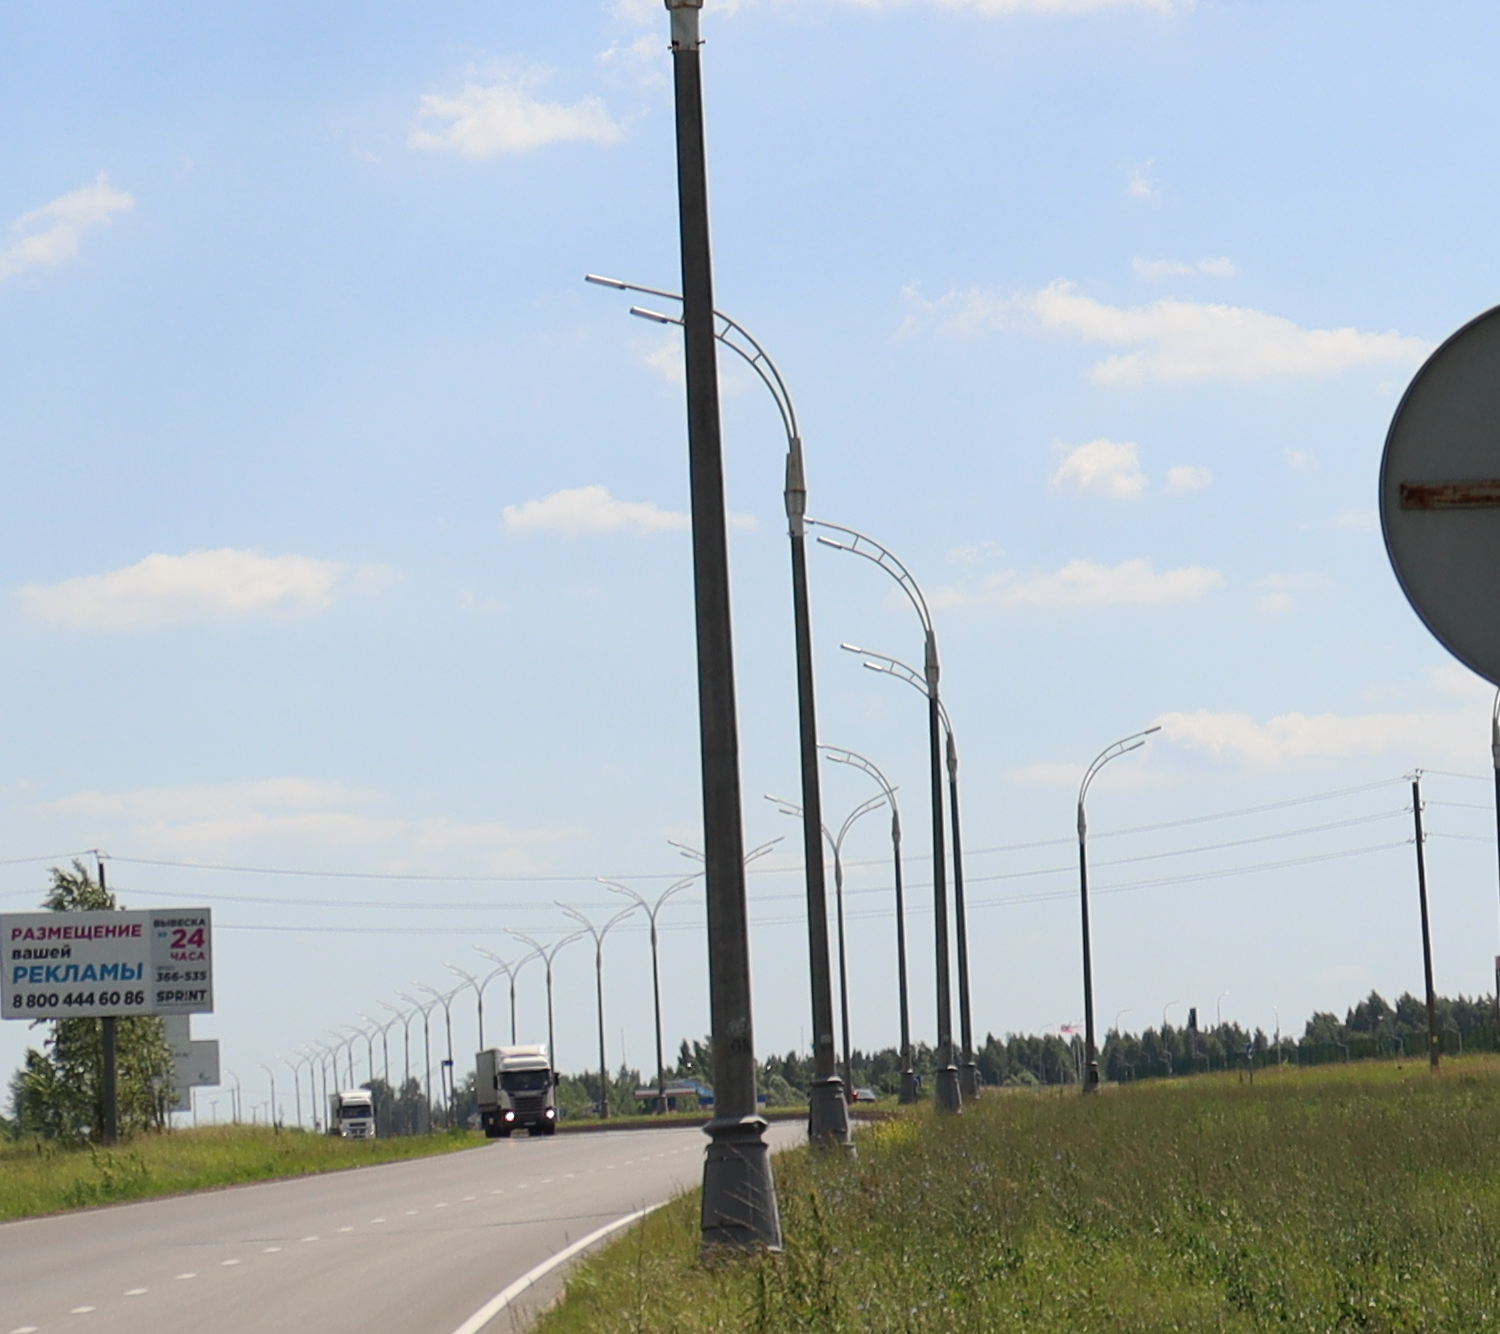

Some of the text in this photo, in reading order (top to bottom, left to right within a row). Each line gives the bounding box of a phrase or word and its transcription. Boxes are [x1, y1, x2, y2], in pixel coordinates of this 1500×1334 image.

[153, 917, 206, 928] ВЫВЕСКА
[11, 924, 143, 941] РАЗМЕЩЕНИЕ
[170, 927, 206, 949] 24
[12, 944, 72, 960] вашей
[170, 951, 206, 962] ЧАСА
[13, 962, 144, 984] РЕКЛАМЫ
[155, 970, 207, 983] 366-535
[13, 990, 145, 1008] 8 800 444 60 86
